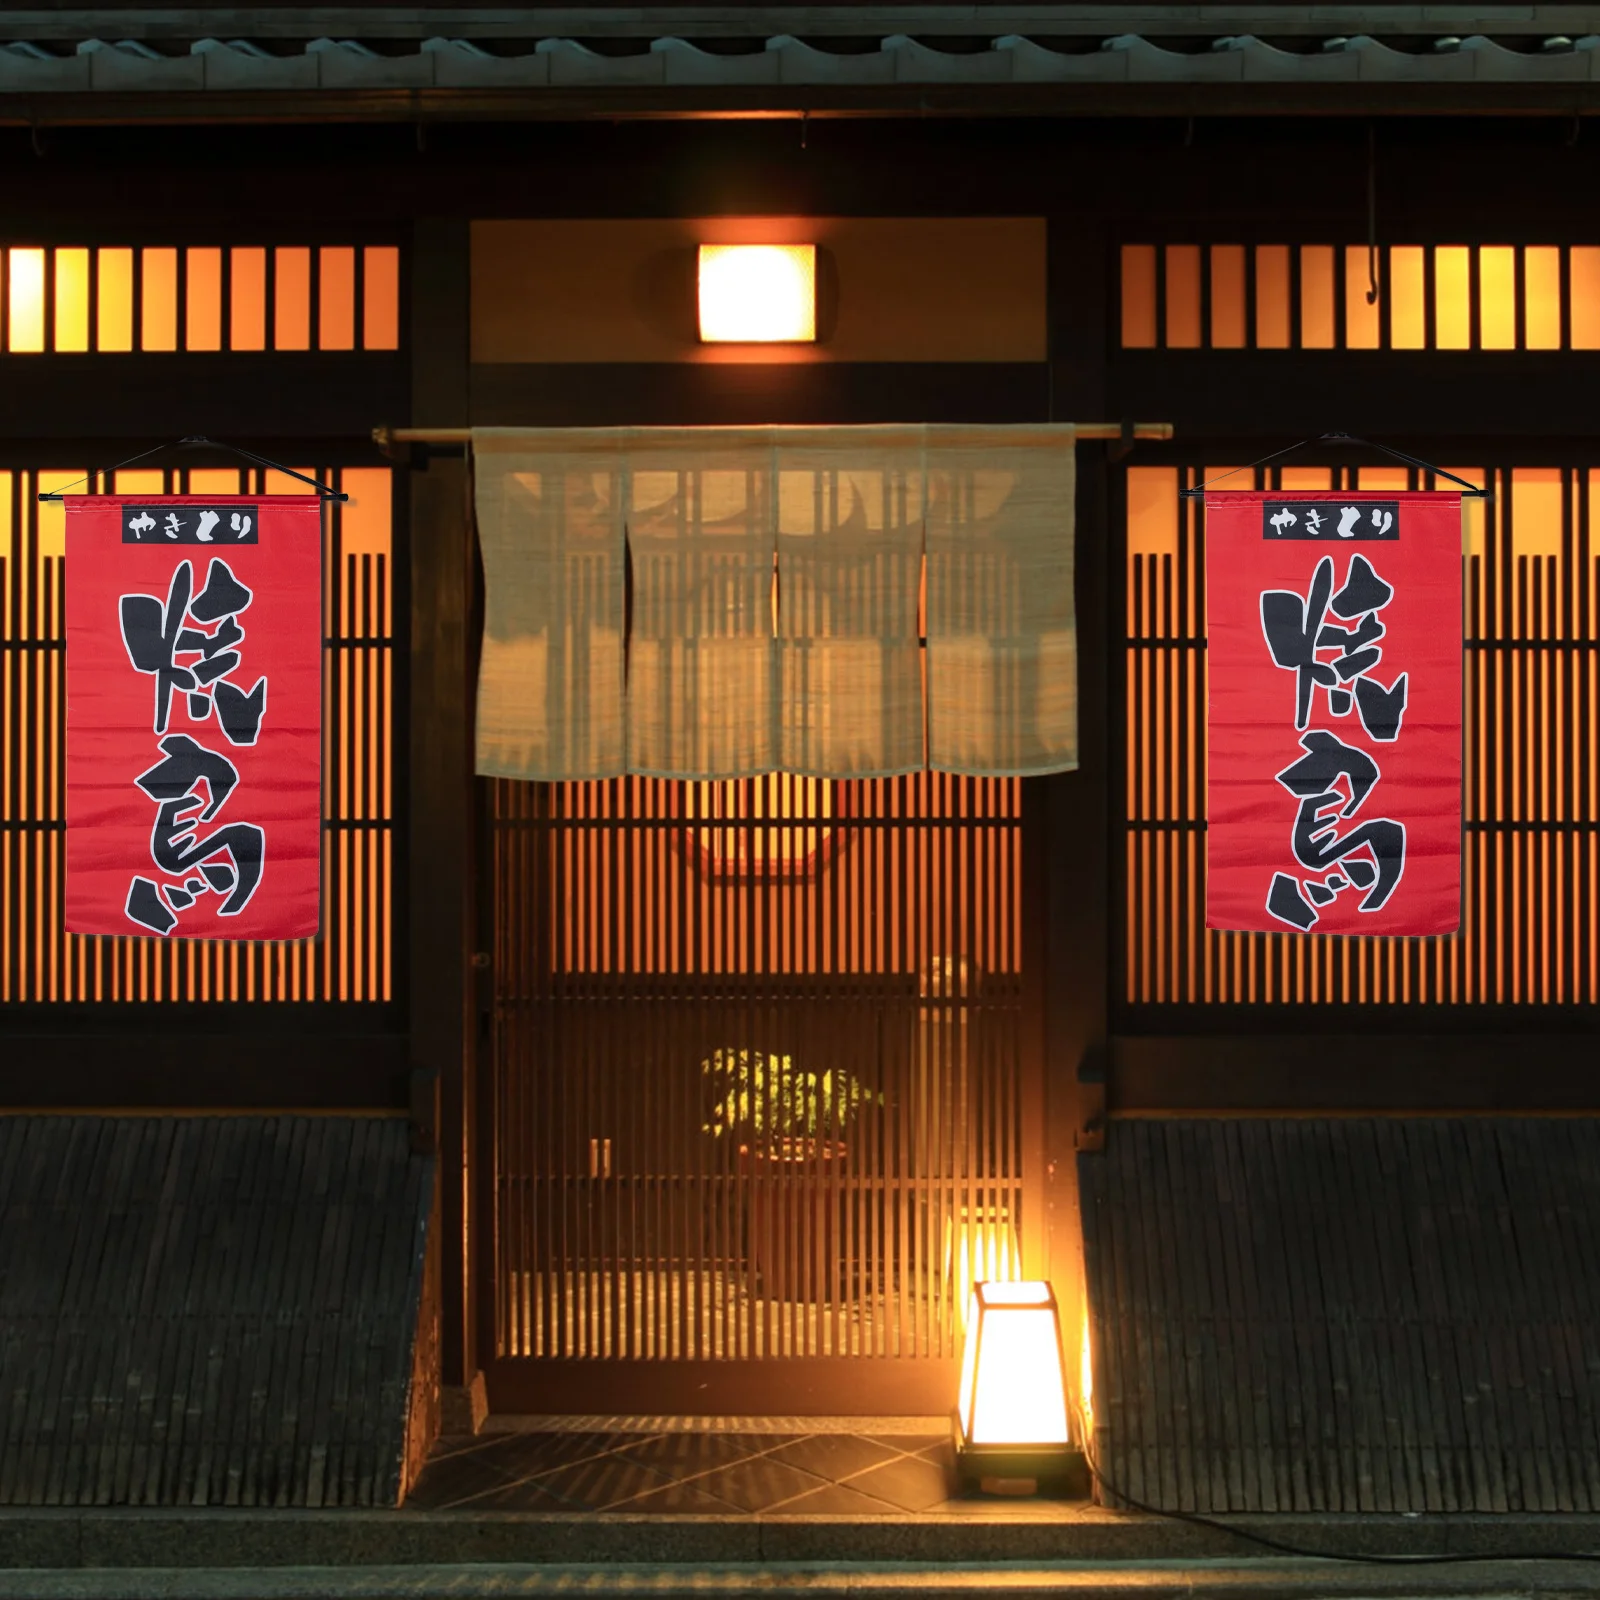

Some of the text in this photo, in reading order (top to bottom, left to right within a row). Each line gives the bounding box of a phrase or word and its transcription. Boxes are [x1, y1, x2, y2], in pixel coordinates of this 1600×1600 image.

[129, 511, 252, 541] やきとり
[1270, 507, 1393, 538] やきとり
